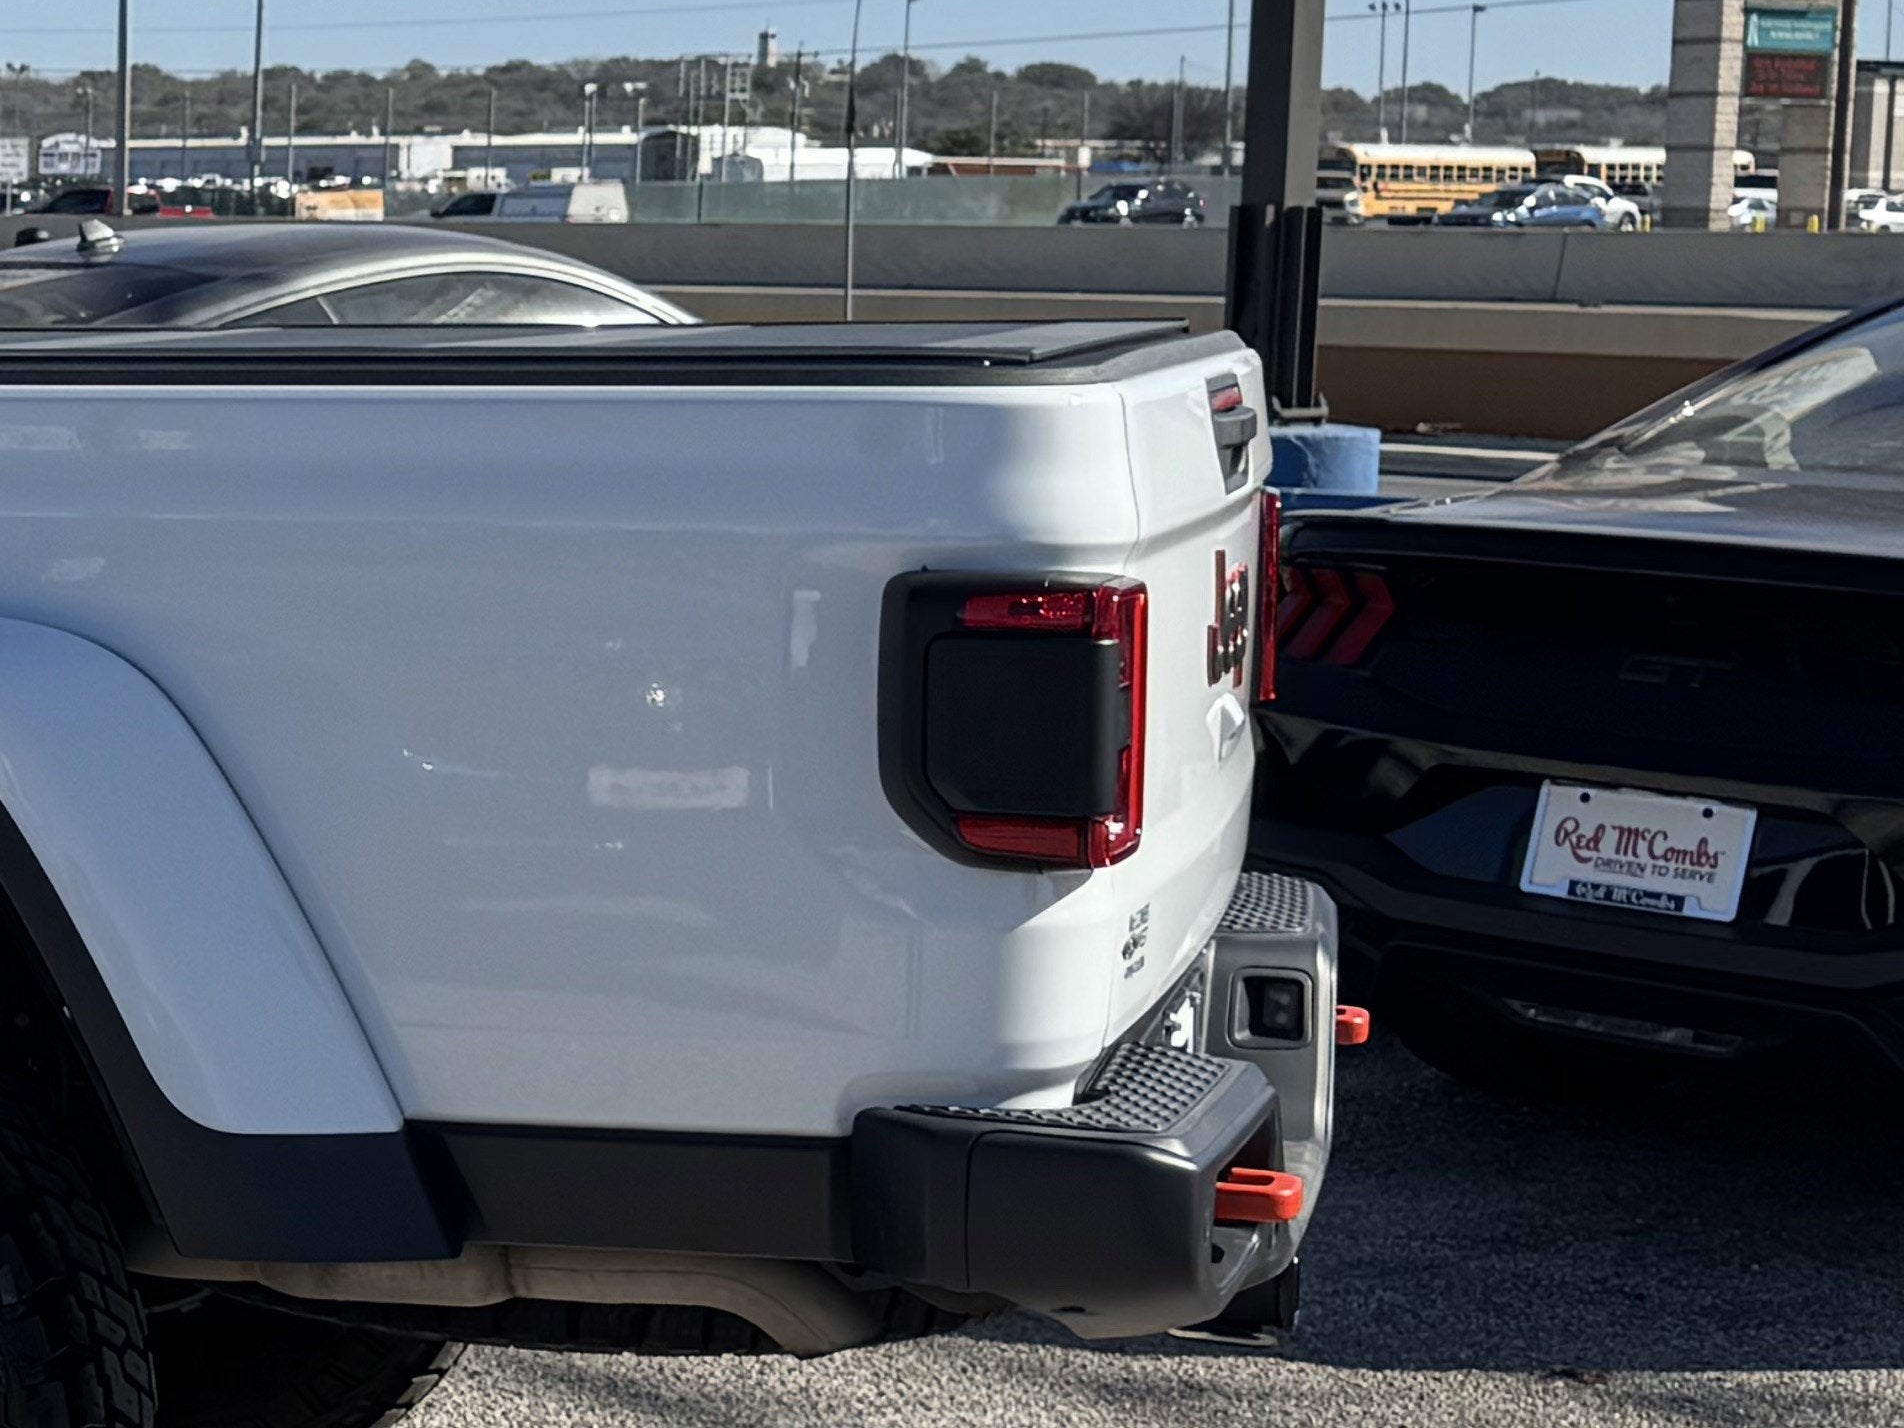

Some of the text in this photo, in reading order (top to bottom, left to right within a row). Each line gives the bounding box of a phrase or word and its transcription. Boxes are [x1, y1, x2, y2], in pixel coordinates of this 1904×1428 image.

[1554, 816, 1720, 870] Red McCombs
[1594, 856, 1718, 884] DRIVEN TO SERVE
